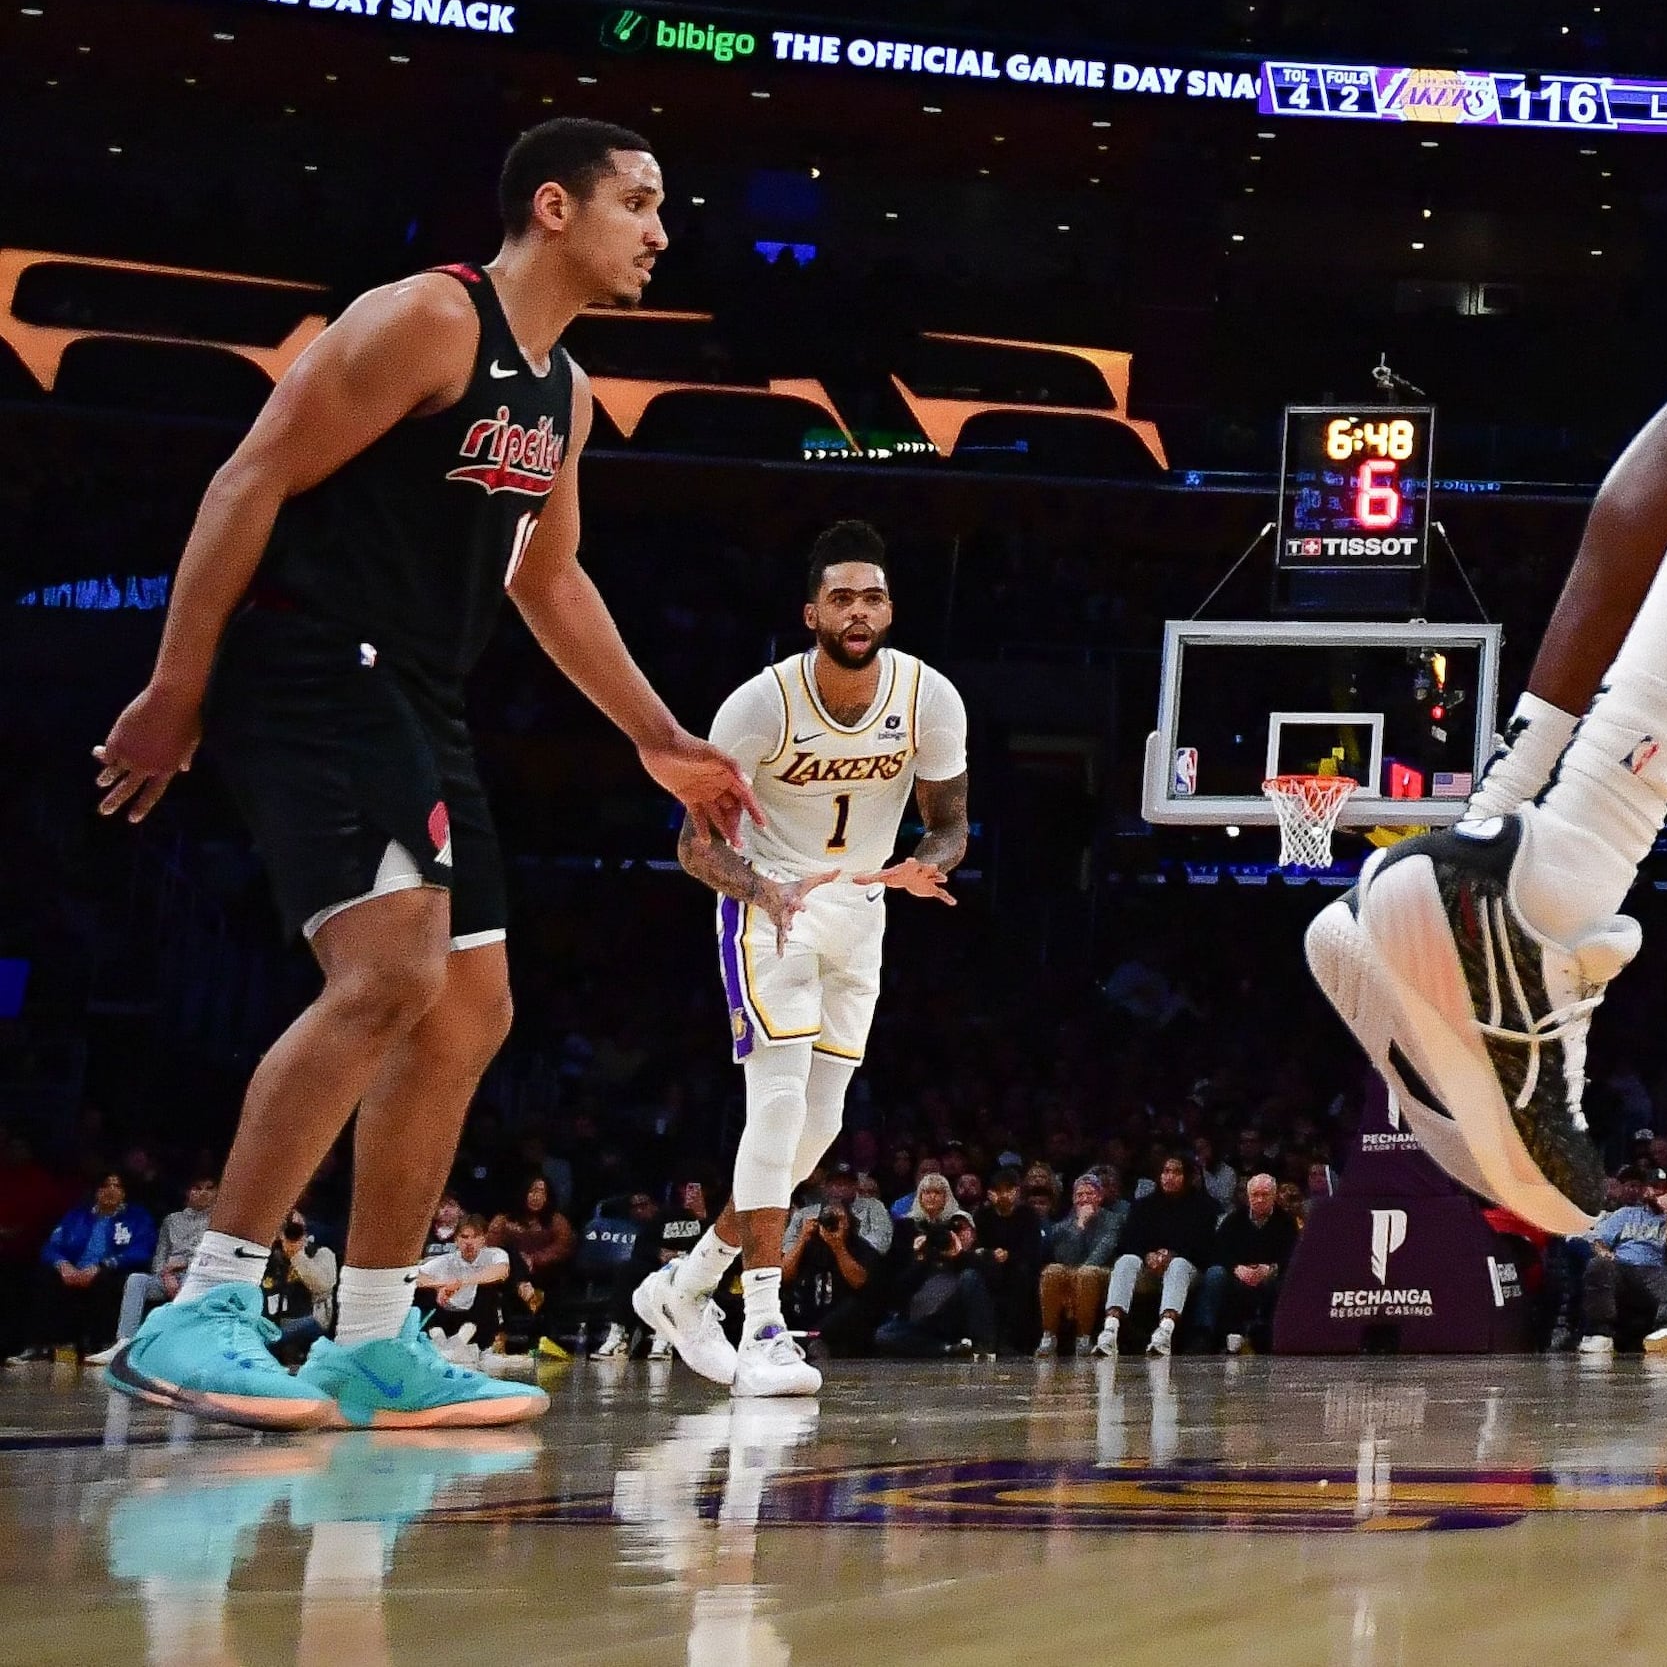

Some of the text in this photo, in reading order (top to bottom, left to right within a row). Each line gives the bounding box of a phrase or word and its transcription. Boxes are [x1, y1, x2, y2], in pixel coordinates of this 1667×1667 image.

[657, 21, 754, 61] bibigo
[772, 32, 1261, 100] THE OFFICIAL GAME DAY SNA
[1282, 69, 1310, 84] TOL
[1326, 70, 1369, 86] FOULS
[1288, 83, 1309, 109] 4
[1338, 85, 1360, 112] 2
[1384, 76, 1488, 109] LAKERS
[1510, 81, 1598, 123] 116
[1327, 417, 1415, 461] 6:48
[1356, 458, 1400, 527] 6
[1325, 537, 1418, 556] TISSOT
[773, 750, 908, 788] LAKERS
[826, 791, 850, 854] 1
[1329, 1305, 1433, 1319] RESORT CASINO
[1330, 1289, 1433, 1307] PECHANGA
